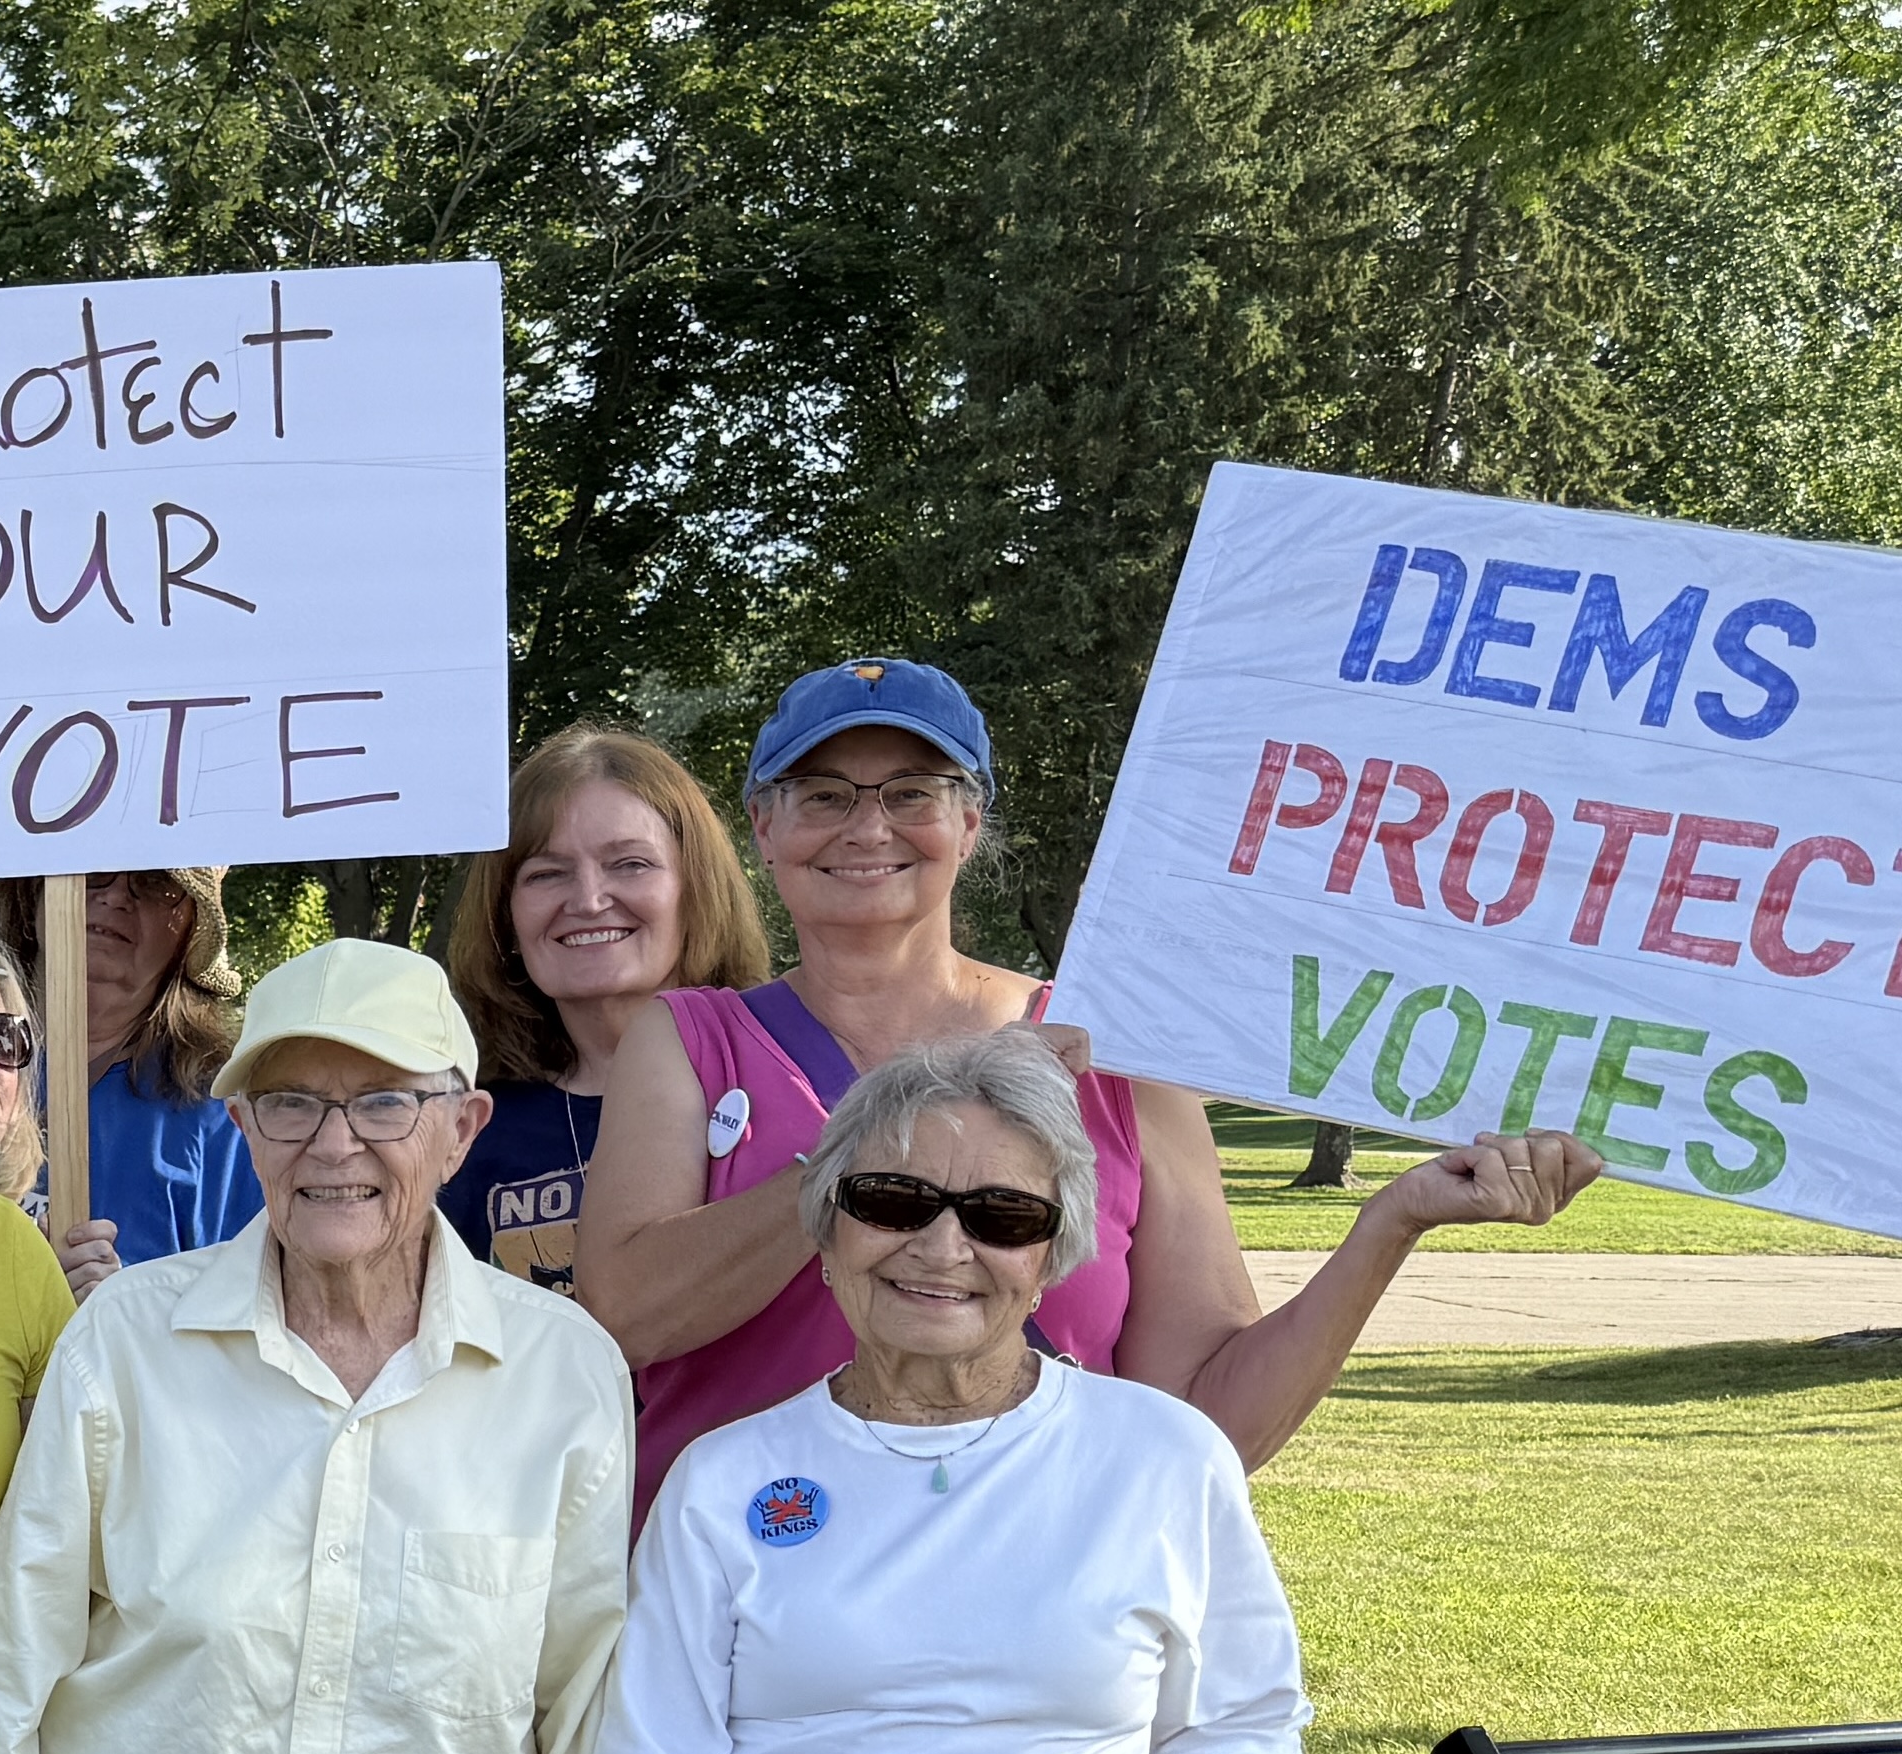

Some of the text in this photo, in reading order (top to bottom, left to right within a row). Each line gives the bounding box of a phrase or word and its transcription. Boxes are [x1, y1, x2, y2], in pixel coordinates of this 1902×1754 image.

[1339, 543, 1818, 742] DEMS
[1227, 739, 1902, 998] PROTEC
[1287, 954, 1809, 1195] VOTES
[499, 1180, 572, 1227] NO
[760, 1518, 819, 1540] KINGS
[771, 1477, 799, 1491] NO
